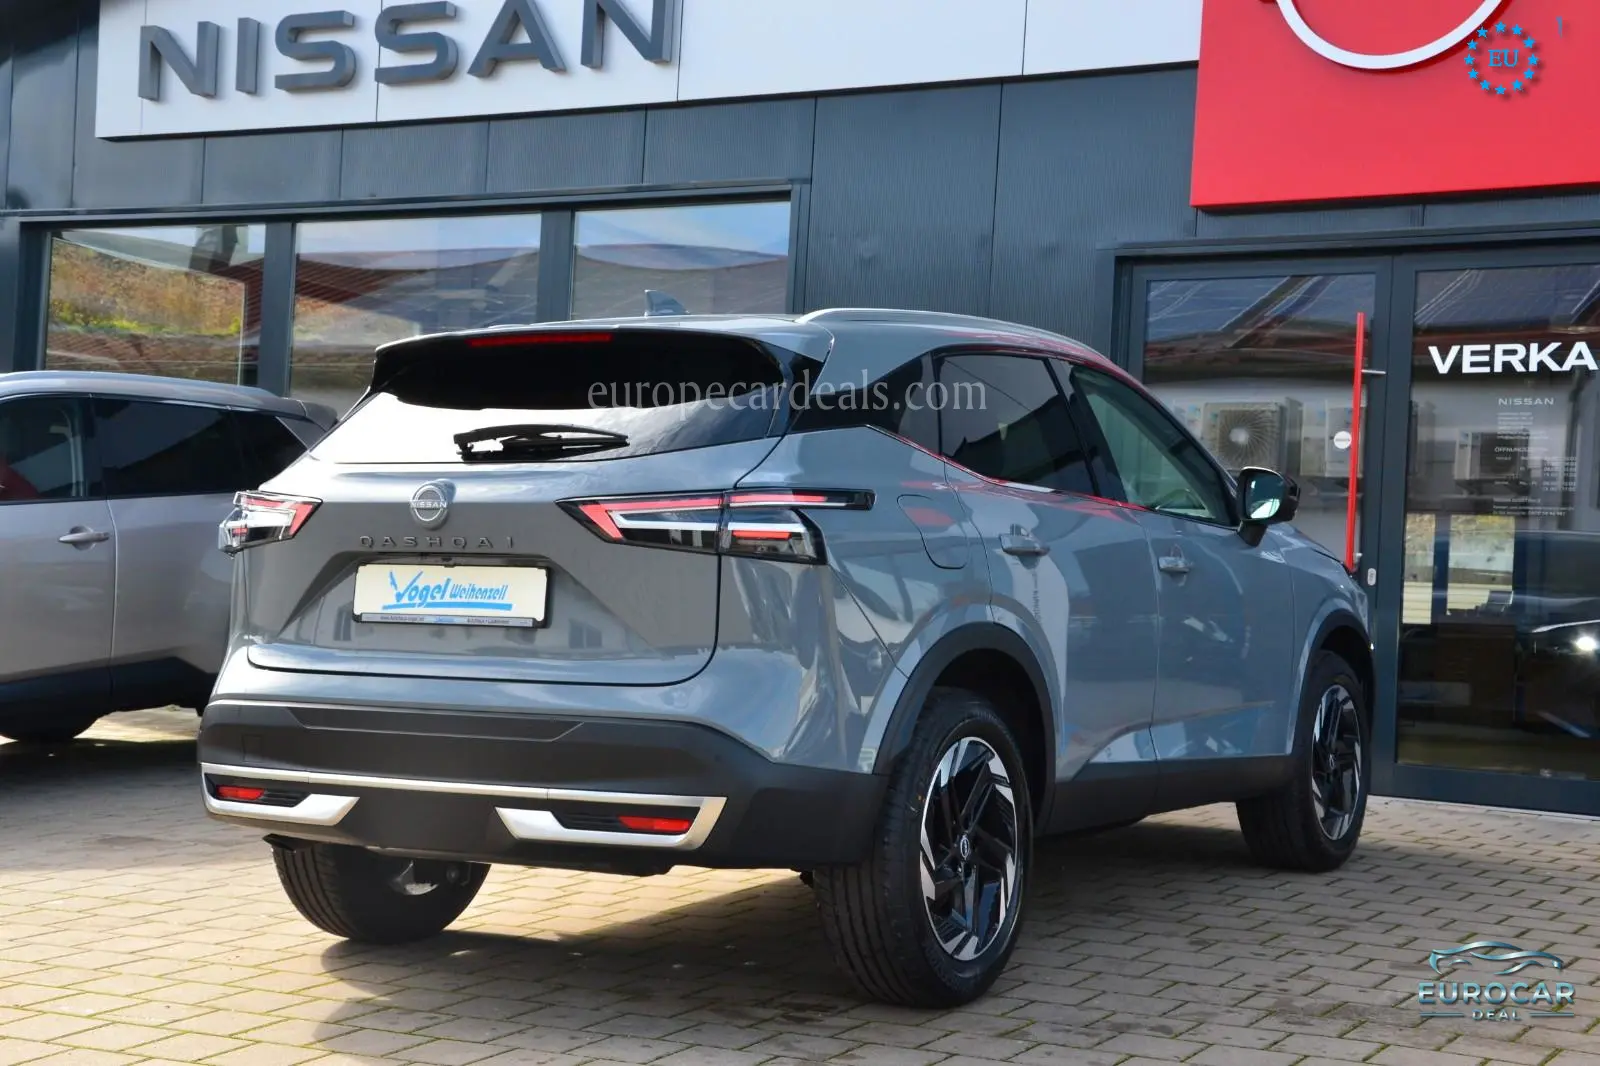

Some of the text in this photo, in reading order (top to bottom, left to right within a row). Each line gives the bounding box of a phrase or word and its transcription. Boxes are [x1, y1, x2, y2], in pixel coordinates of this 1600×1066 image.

[138, 0, 674, 100] NISSAN
[1428, 341, 1599, 374] VERKA
[1498, 397, 1555, 406] NISSAN
[359, 535, 515, 549] QASHQAI
[389, 570, 509, 607] Vogel Weihenzell
